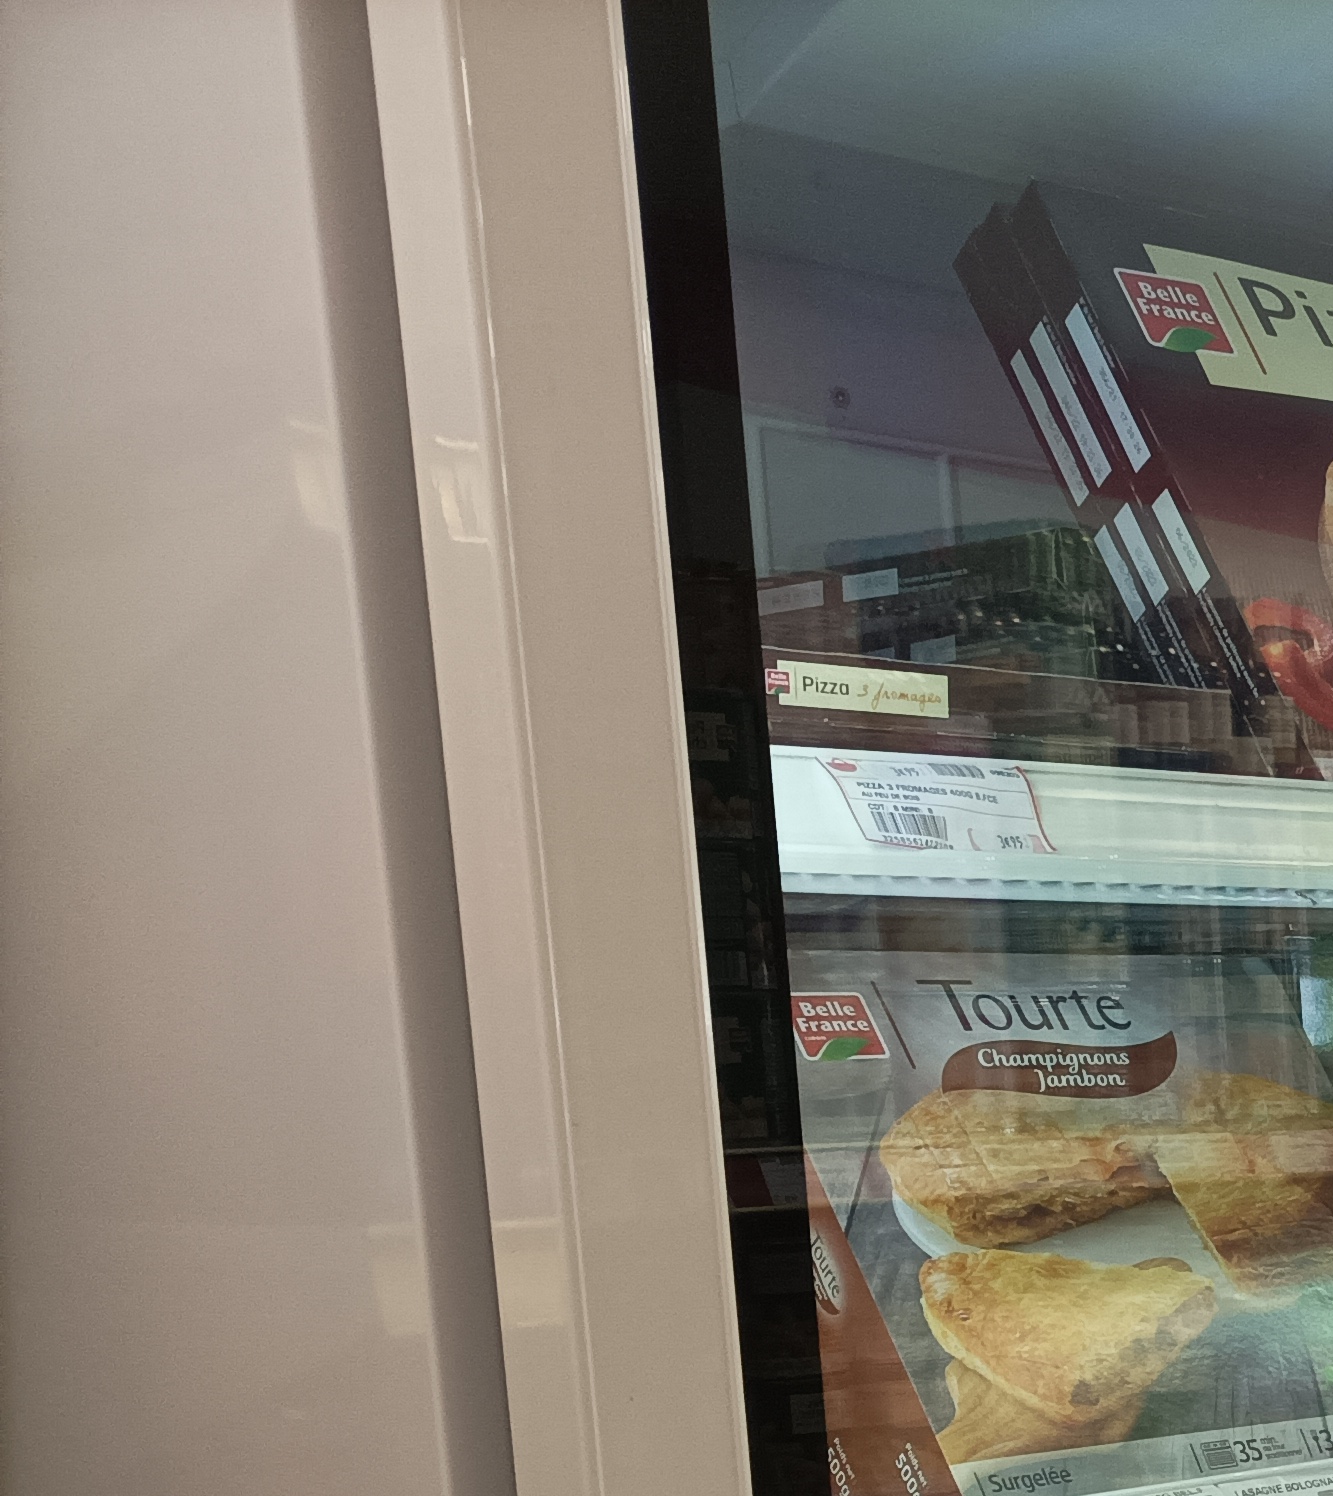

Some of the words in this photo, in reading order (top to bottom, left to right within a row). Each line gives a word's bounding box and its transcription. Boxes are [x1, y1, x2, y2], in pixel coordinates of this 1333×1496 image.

[1137, 281, 1200, 307] Belle
[1138, 300, 1214, 326] France
[802, 675, 850, 697] Pizza
[857, 685, 869, 697] 3
[871, 683, 942, 710] fromages
[857, 781, 884, 790] PIZZA
[896, 784, 947, 796] FROMAGES
[799, 1000, 856, 1018] Belle
[916, 980, 1132, 1032] Tourte
[796, 1015, 870, 1033] France
[977, 1048, 1130, 1072] Champignons
[1040, 1069, 1125, 1092] Jambon
[810, 1230, 841, 1299] Tourte
[1233, 1438, 1263, 1463] 35
[988, 1465, 1073, 1494] Surgelée
